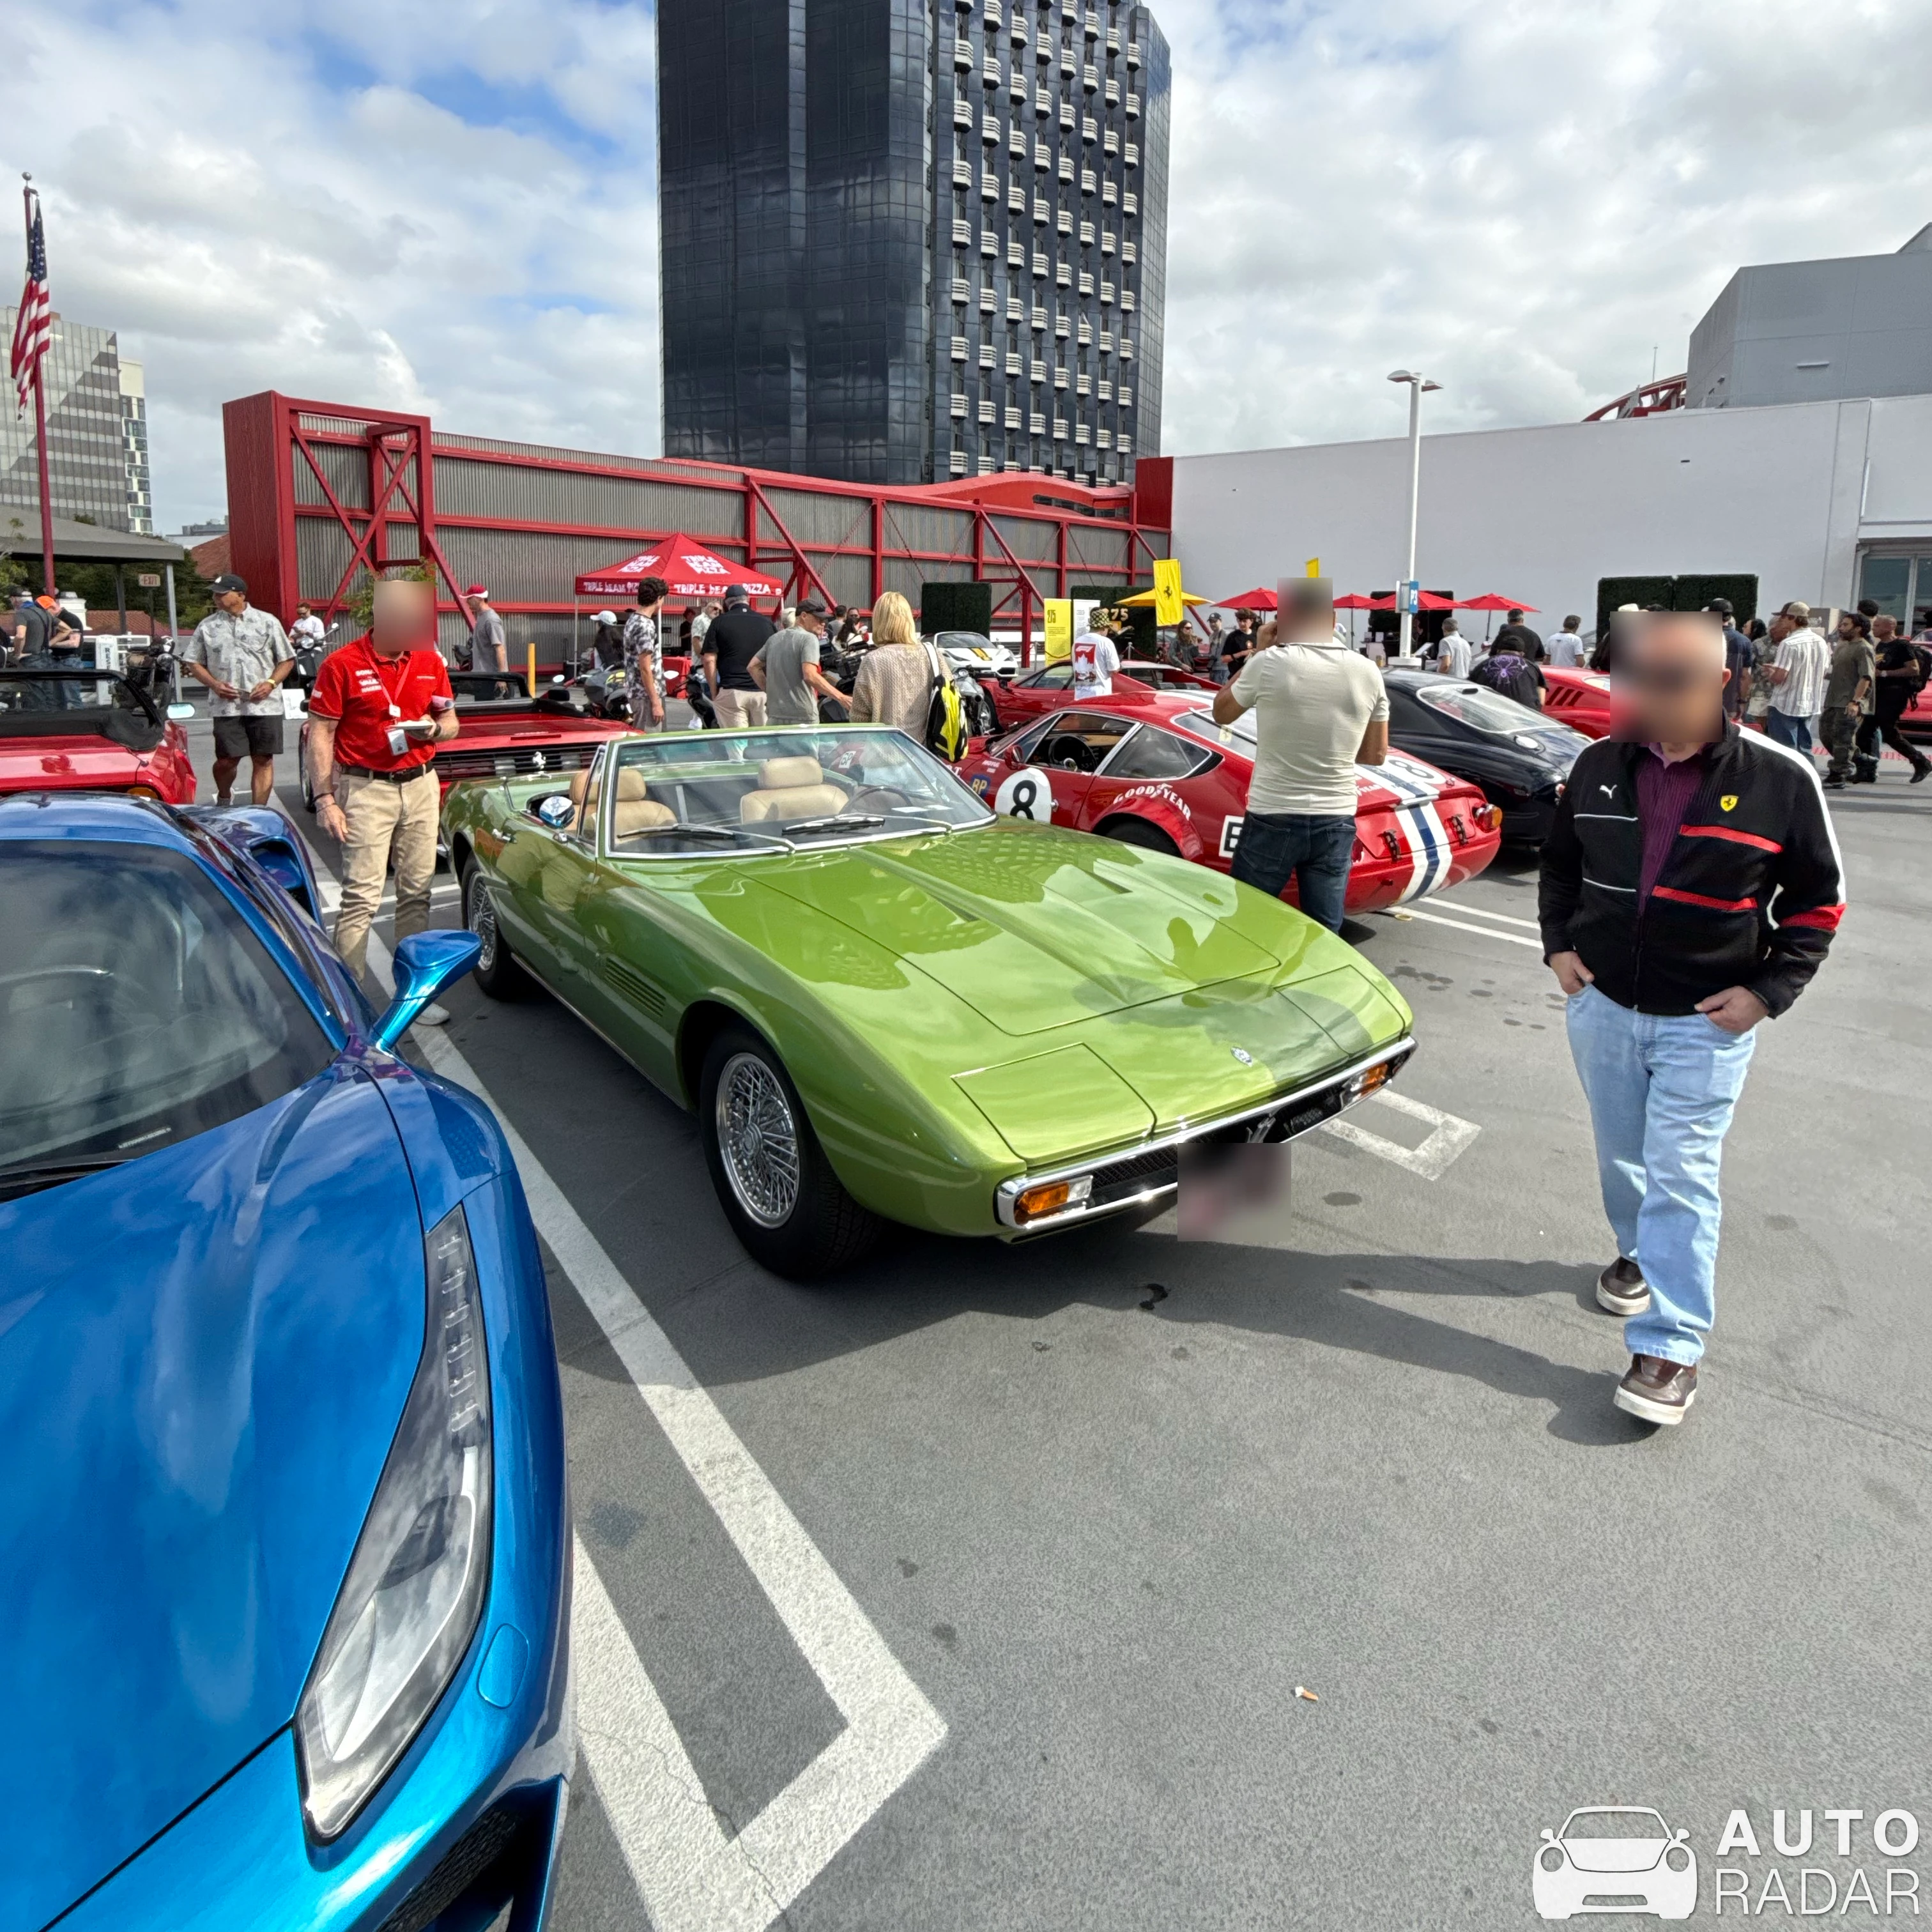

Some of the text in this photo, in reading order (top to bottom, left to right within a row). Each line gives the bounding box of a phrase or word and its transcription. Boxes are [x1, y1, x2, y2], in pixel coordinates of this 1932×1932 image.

[143, 576, 157, 585] EXIT
[583, 581, 603, 592] TRIPLE
[627, 581, 640, 593] PIZ
[673, 583, 705, 594] TRIPLE
[742, 583, 771, 595] PIZZA
[1410, 589, 1418, 605] P3
[1047, 610, 1056, 624] 275
[1388, 759, 1434, 779] 8
[972, 778, 987, 795] BP
[1009, 779, 1036, 820] 8
[1113, 785, 1190, 821] GOODYEAR
